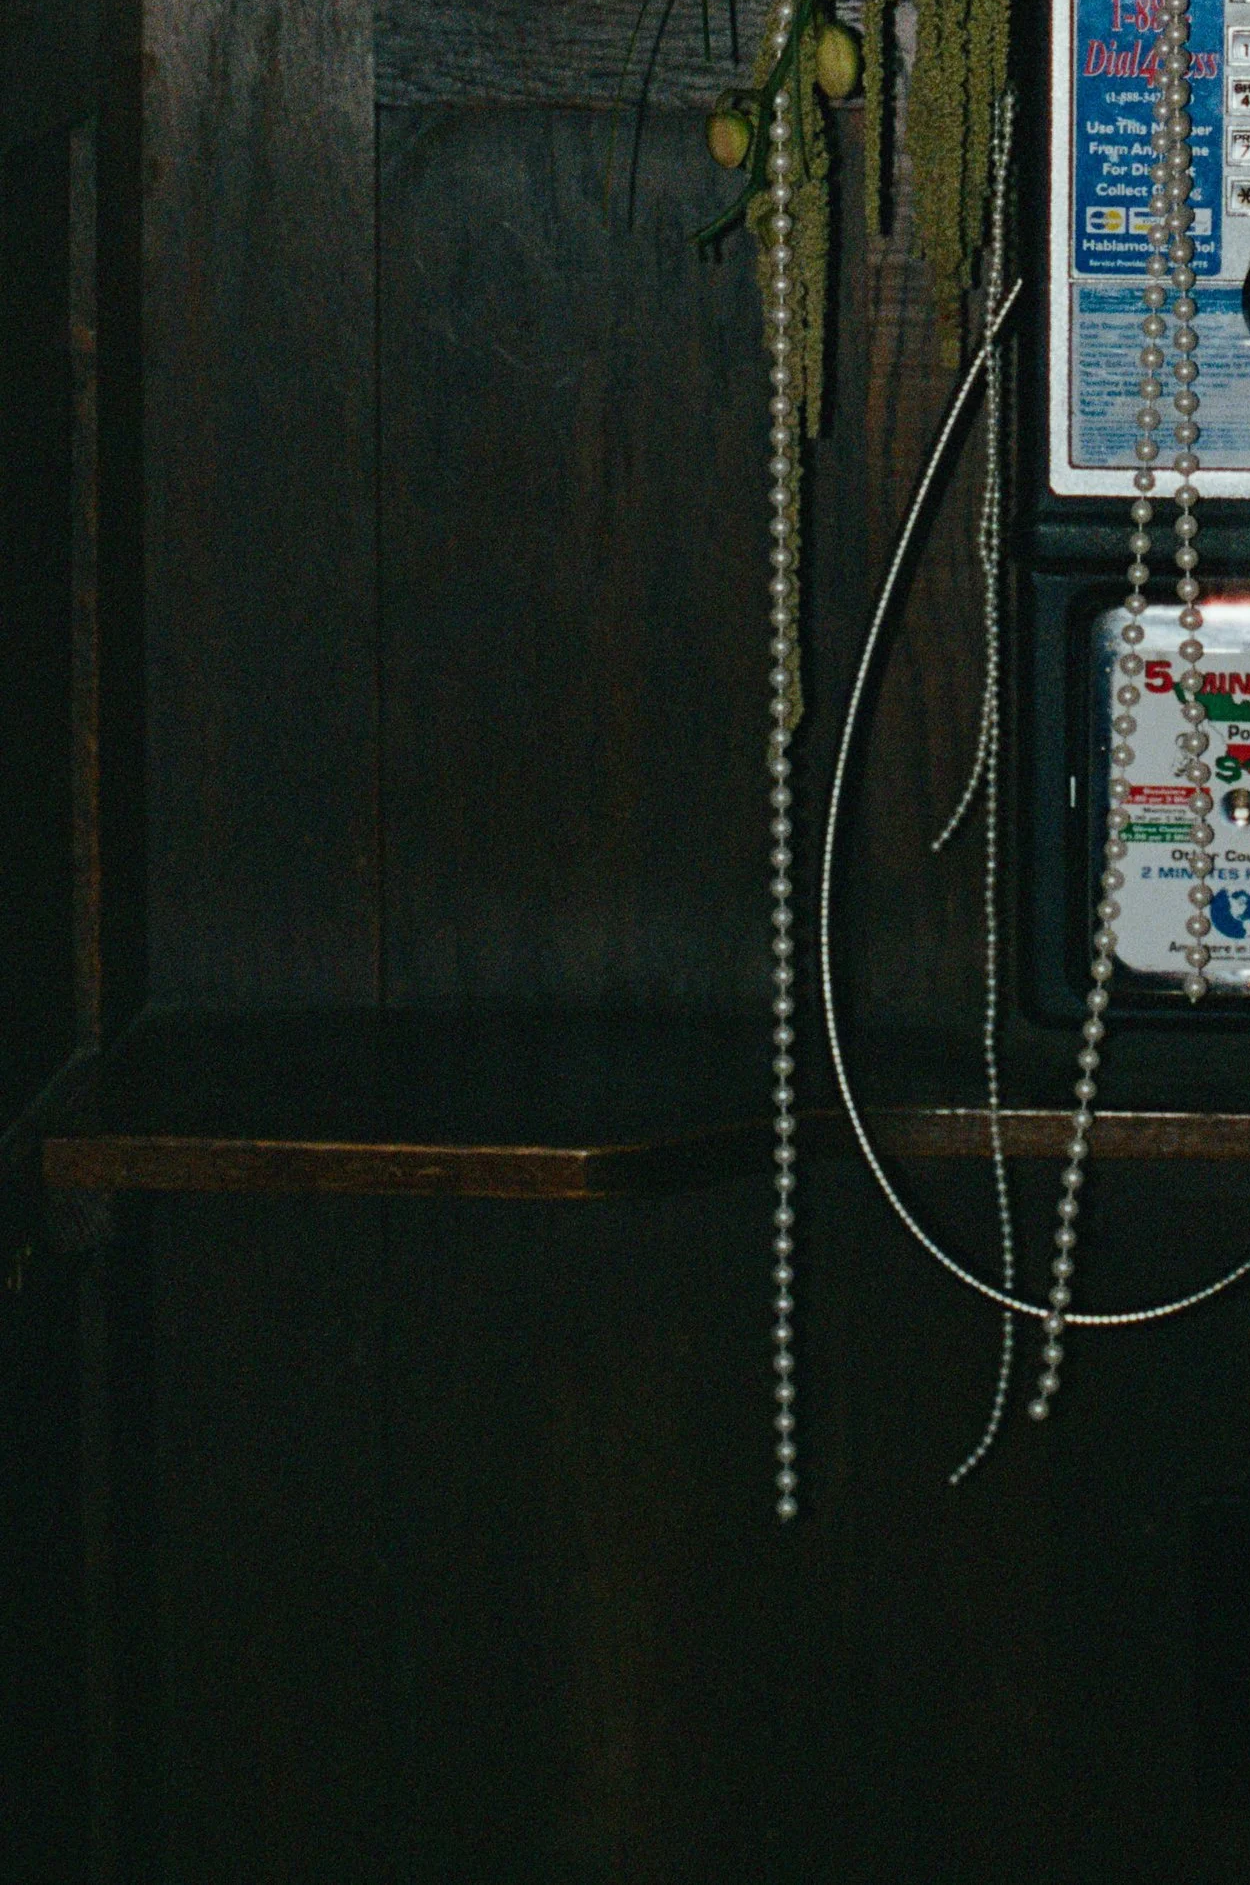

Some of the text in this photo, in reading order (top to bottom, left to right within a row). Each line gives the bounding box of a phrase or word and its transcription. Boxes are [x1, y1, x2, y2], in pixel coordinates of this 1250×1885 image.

[1242, 44, 1249, 58] 1
[1241, 95, 1250, 108] 4
[1086, 120, 1115, 135] Use
[1116, 119, 1147, 135] This
[1240, 144, 1250, 158] 7
[1102, 163, 1128, 176] For
[1096, 183, 1148, 197] Collect
[1143, 659, 1174, 694] 5
[1140, 867, 1152, 879] 2
[1158, 867, 1240, 881] MINTES
[1235, 943, 1246, 954] in
